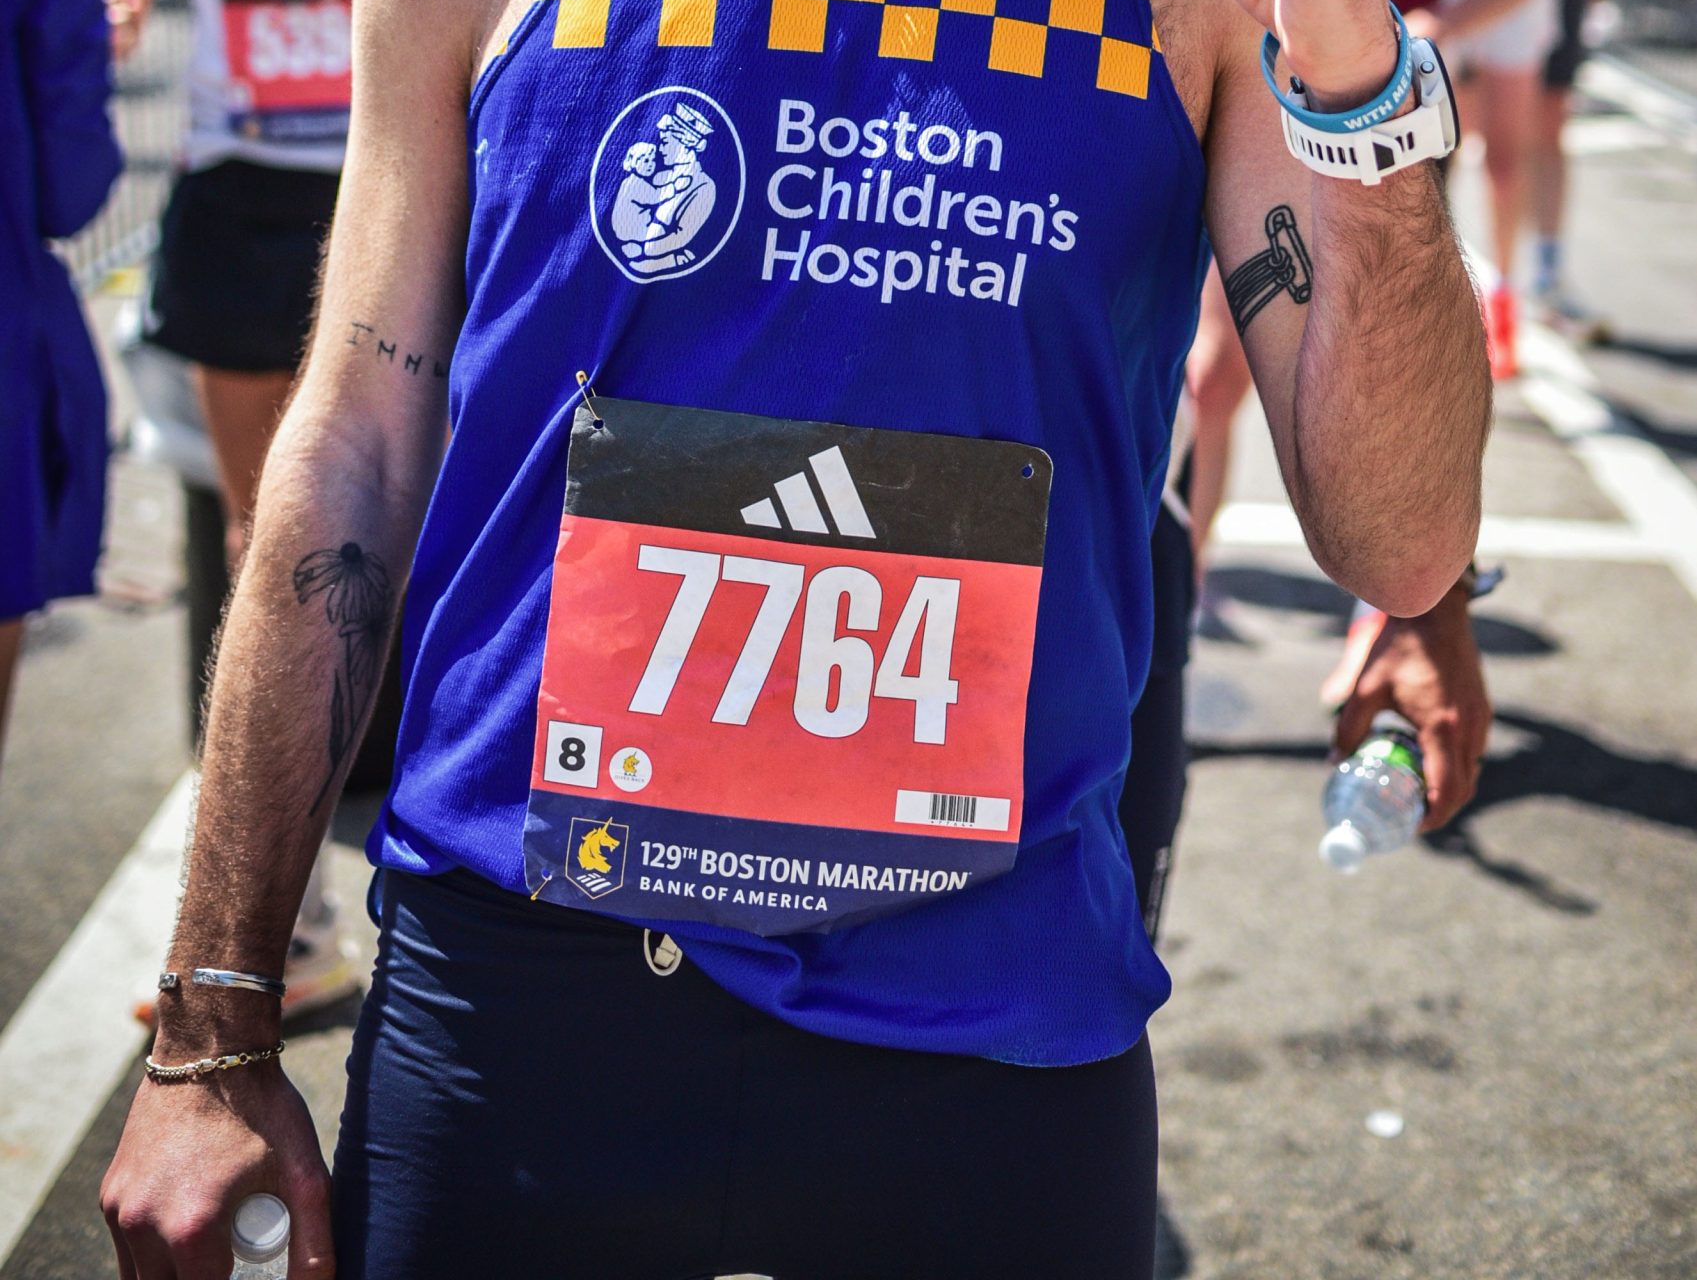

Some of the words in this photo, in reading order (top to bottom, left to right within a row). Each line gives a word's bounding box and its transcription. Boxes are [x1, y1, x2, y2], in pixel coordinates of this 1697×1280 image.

[776, 99, 1003, 171] Boston
[1343, 100, 1394, 131] WITH
[767, 163, 1079, 251] Children's
[761, 227, 1027, 307] Hospital
[627, 543, 962, 746] 7764
[558, 736, 586, 772] 8
[639, 876, 696, 898] BANK
[701, 885, 729, 901] OF
[732, 888, 829, 912] AMERICA
[640, 841, 698, 870] 129TH
[699, 849, 811, 884] BOSTON
[816, 861, 968, 893] MARATHON
